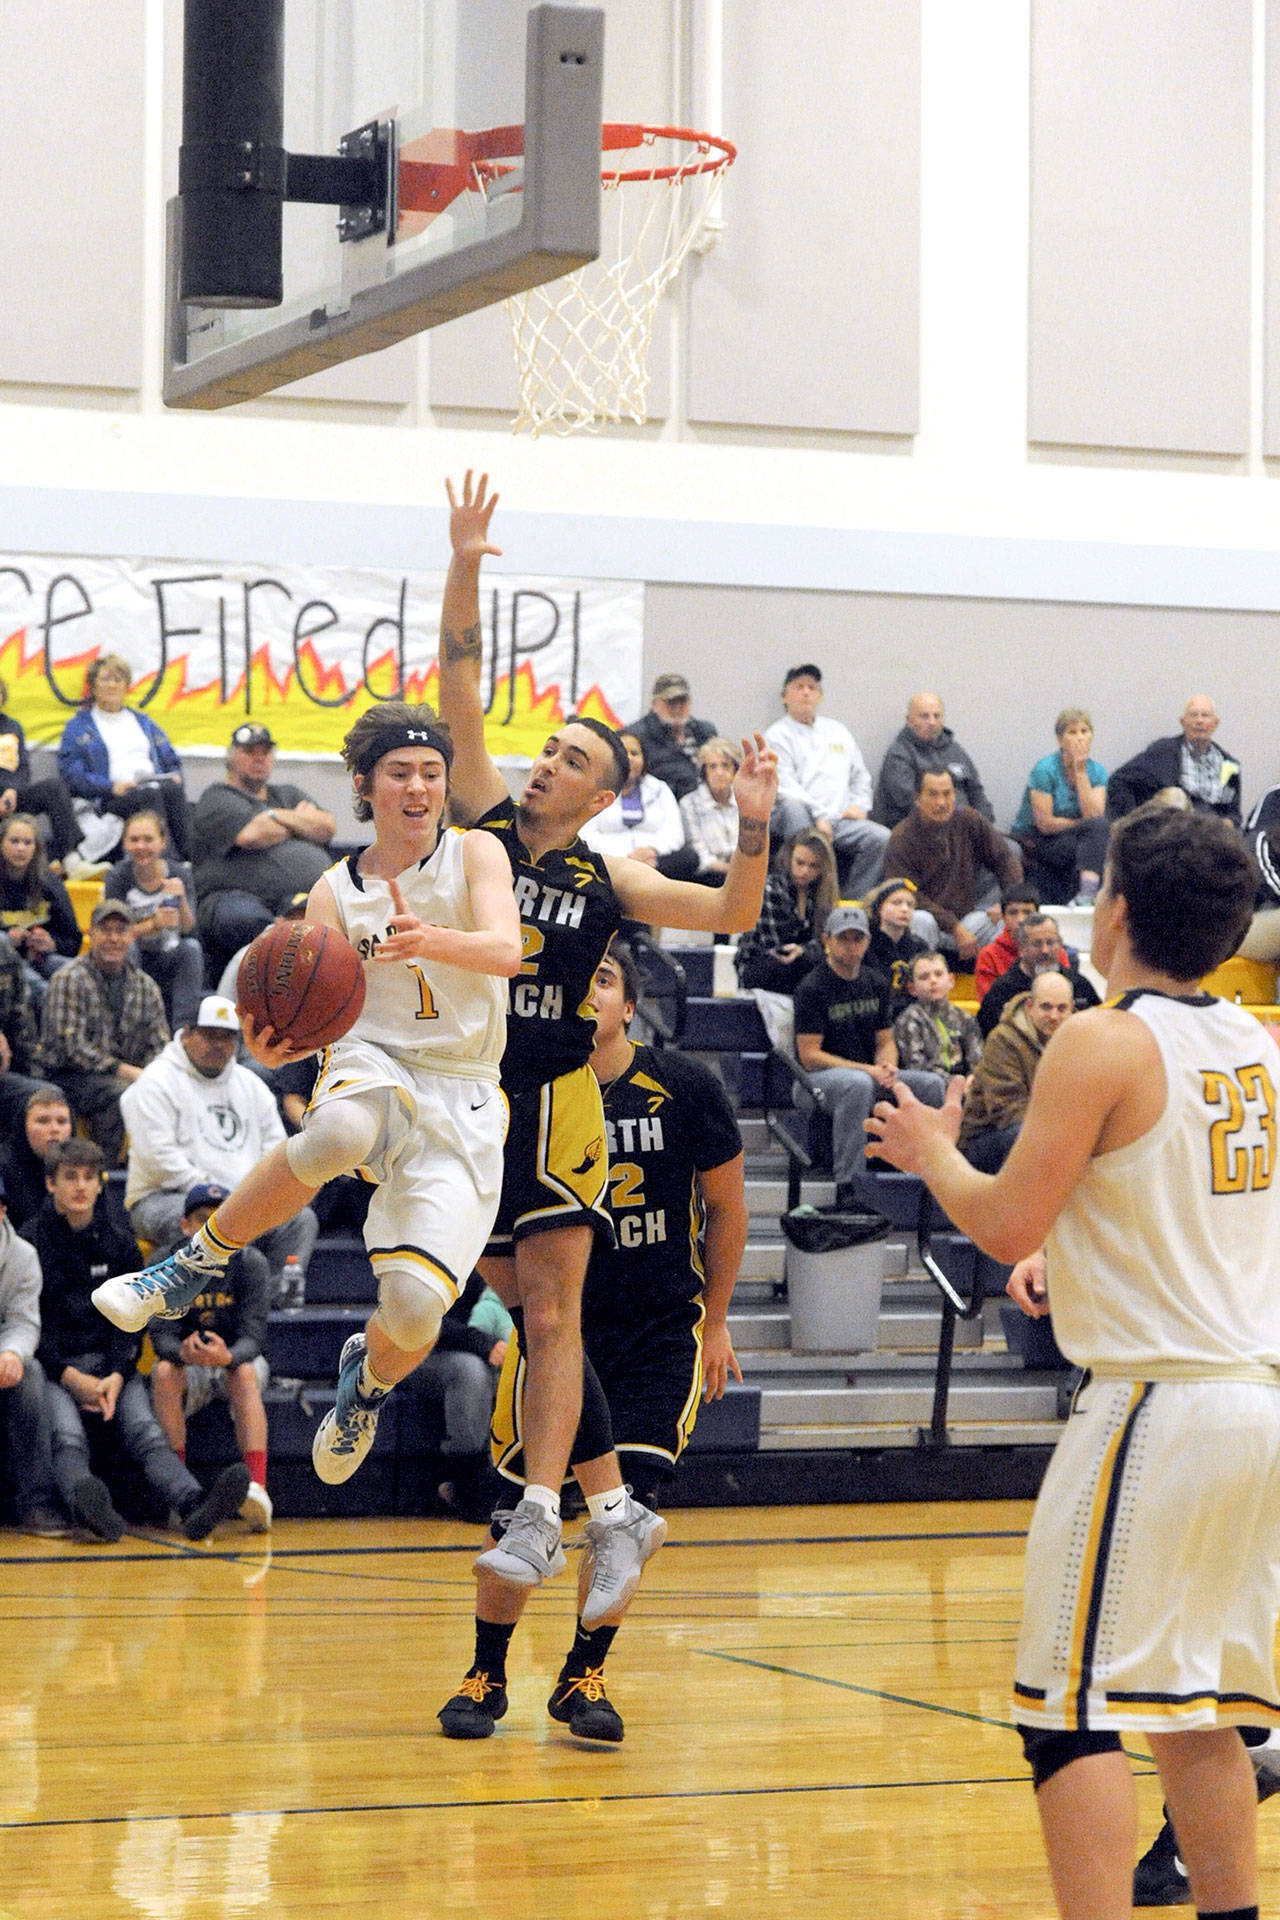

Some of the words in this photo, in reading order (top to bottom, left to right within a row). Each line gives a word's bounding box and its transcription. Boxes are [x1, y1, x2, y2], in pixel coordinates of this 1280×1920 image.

[138, 574, 407, 716] Fired
[514, 875, 587, 929] RTH
[404, 963, 440, 1020] 1
[508, 983, 564, 1020] CH
[604, 1116, 665, 1154] RTH
[1198, 1062, 1278, 1196] 23
[609, 1161, 646, 1209] 2
[619, 1208, 668, 1249] CH
